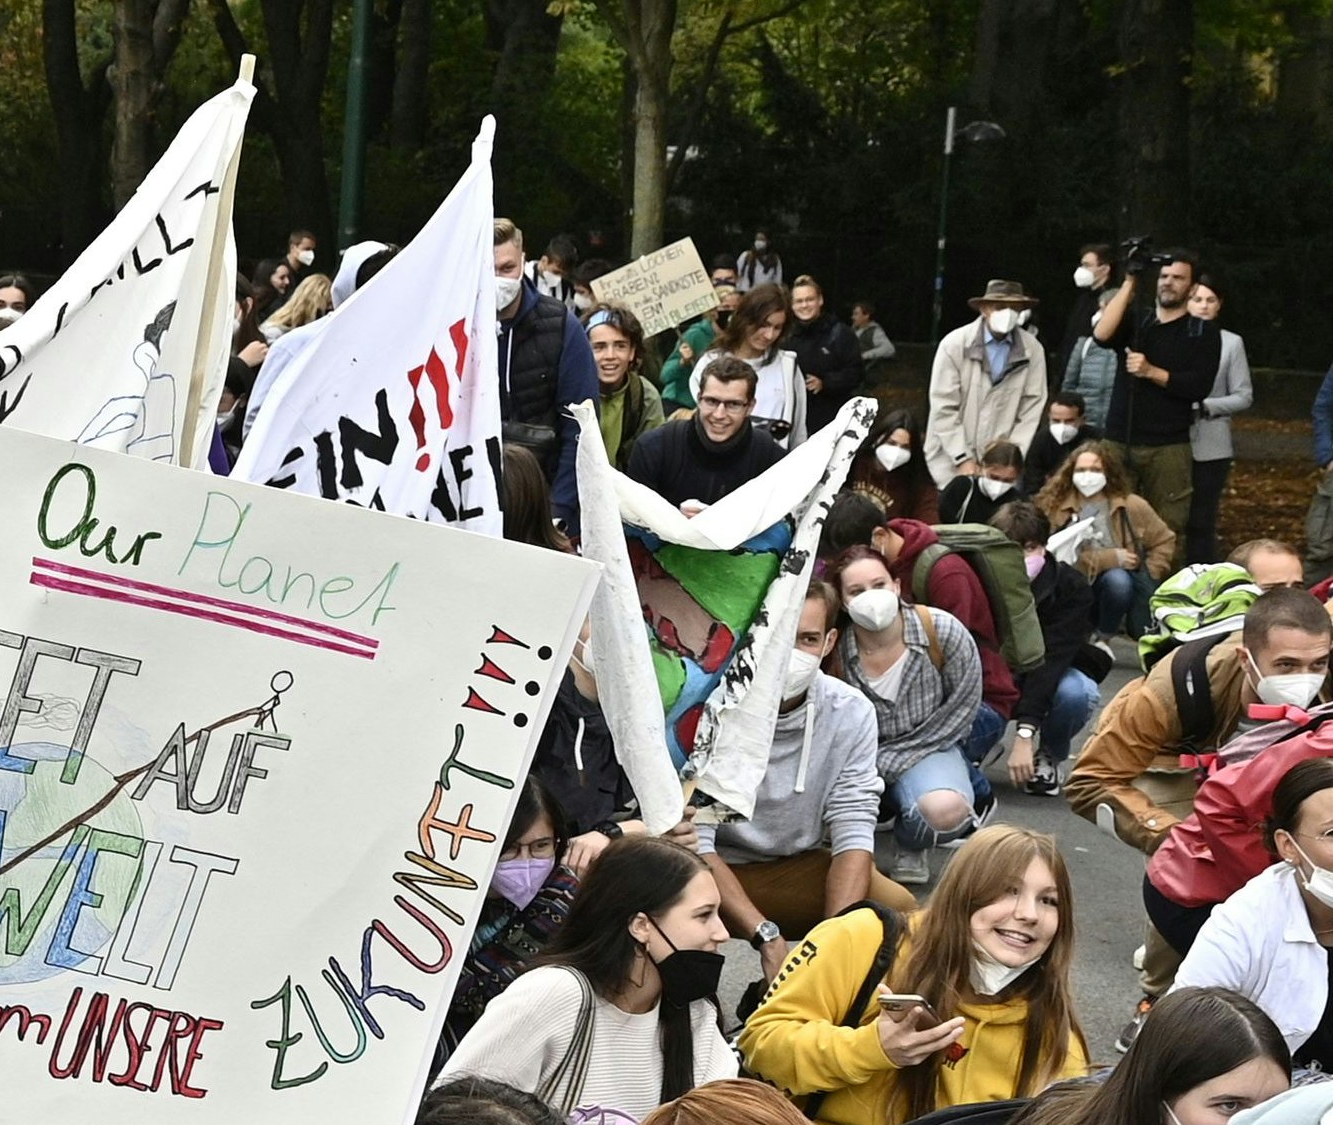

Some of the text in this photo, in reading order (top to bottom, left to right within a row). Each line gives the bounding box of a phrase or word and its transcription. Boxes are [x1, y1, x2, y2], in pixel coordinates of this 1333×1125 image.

[35, 461, 164, 567] Our
[178, 490, 404, 627] Planet
[132, 721, 293, 816] AUF
[47, 986, 225, 1100] UNSERE
